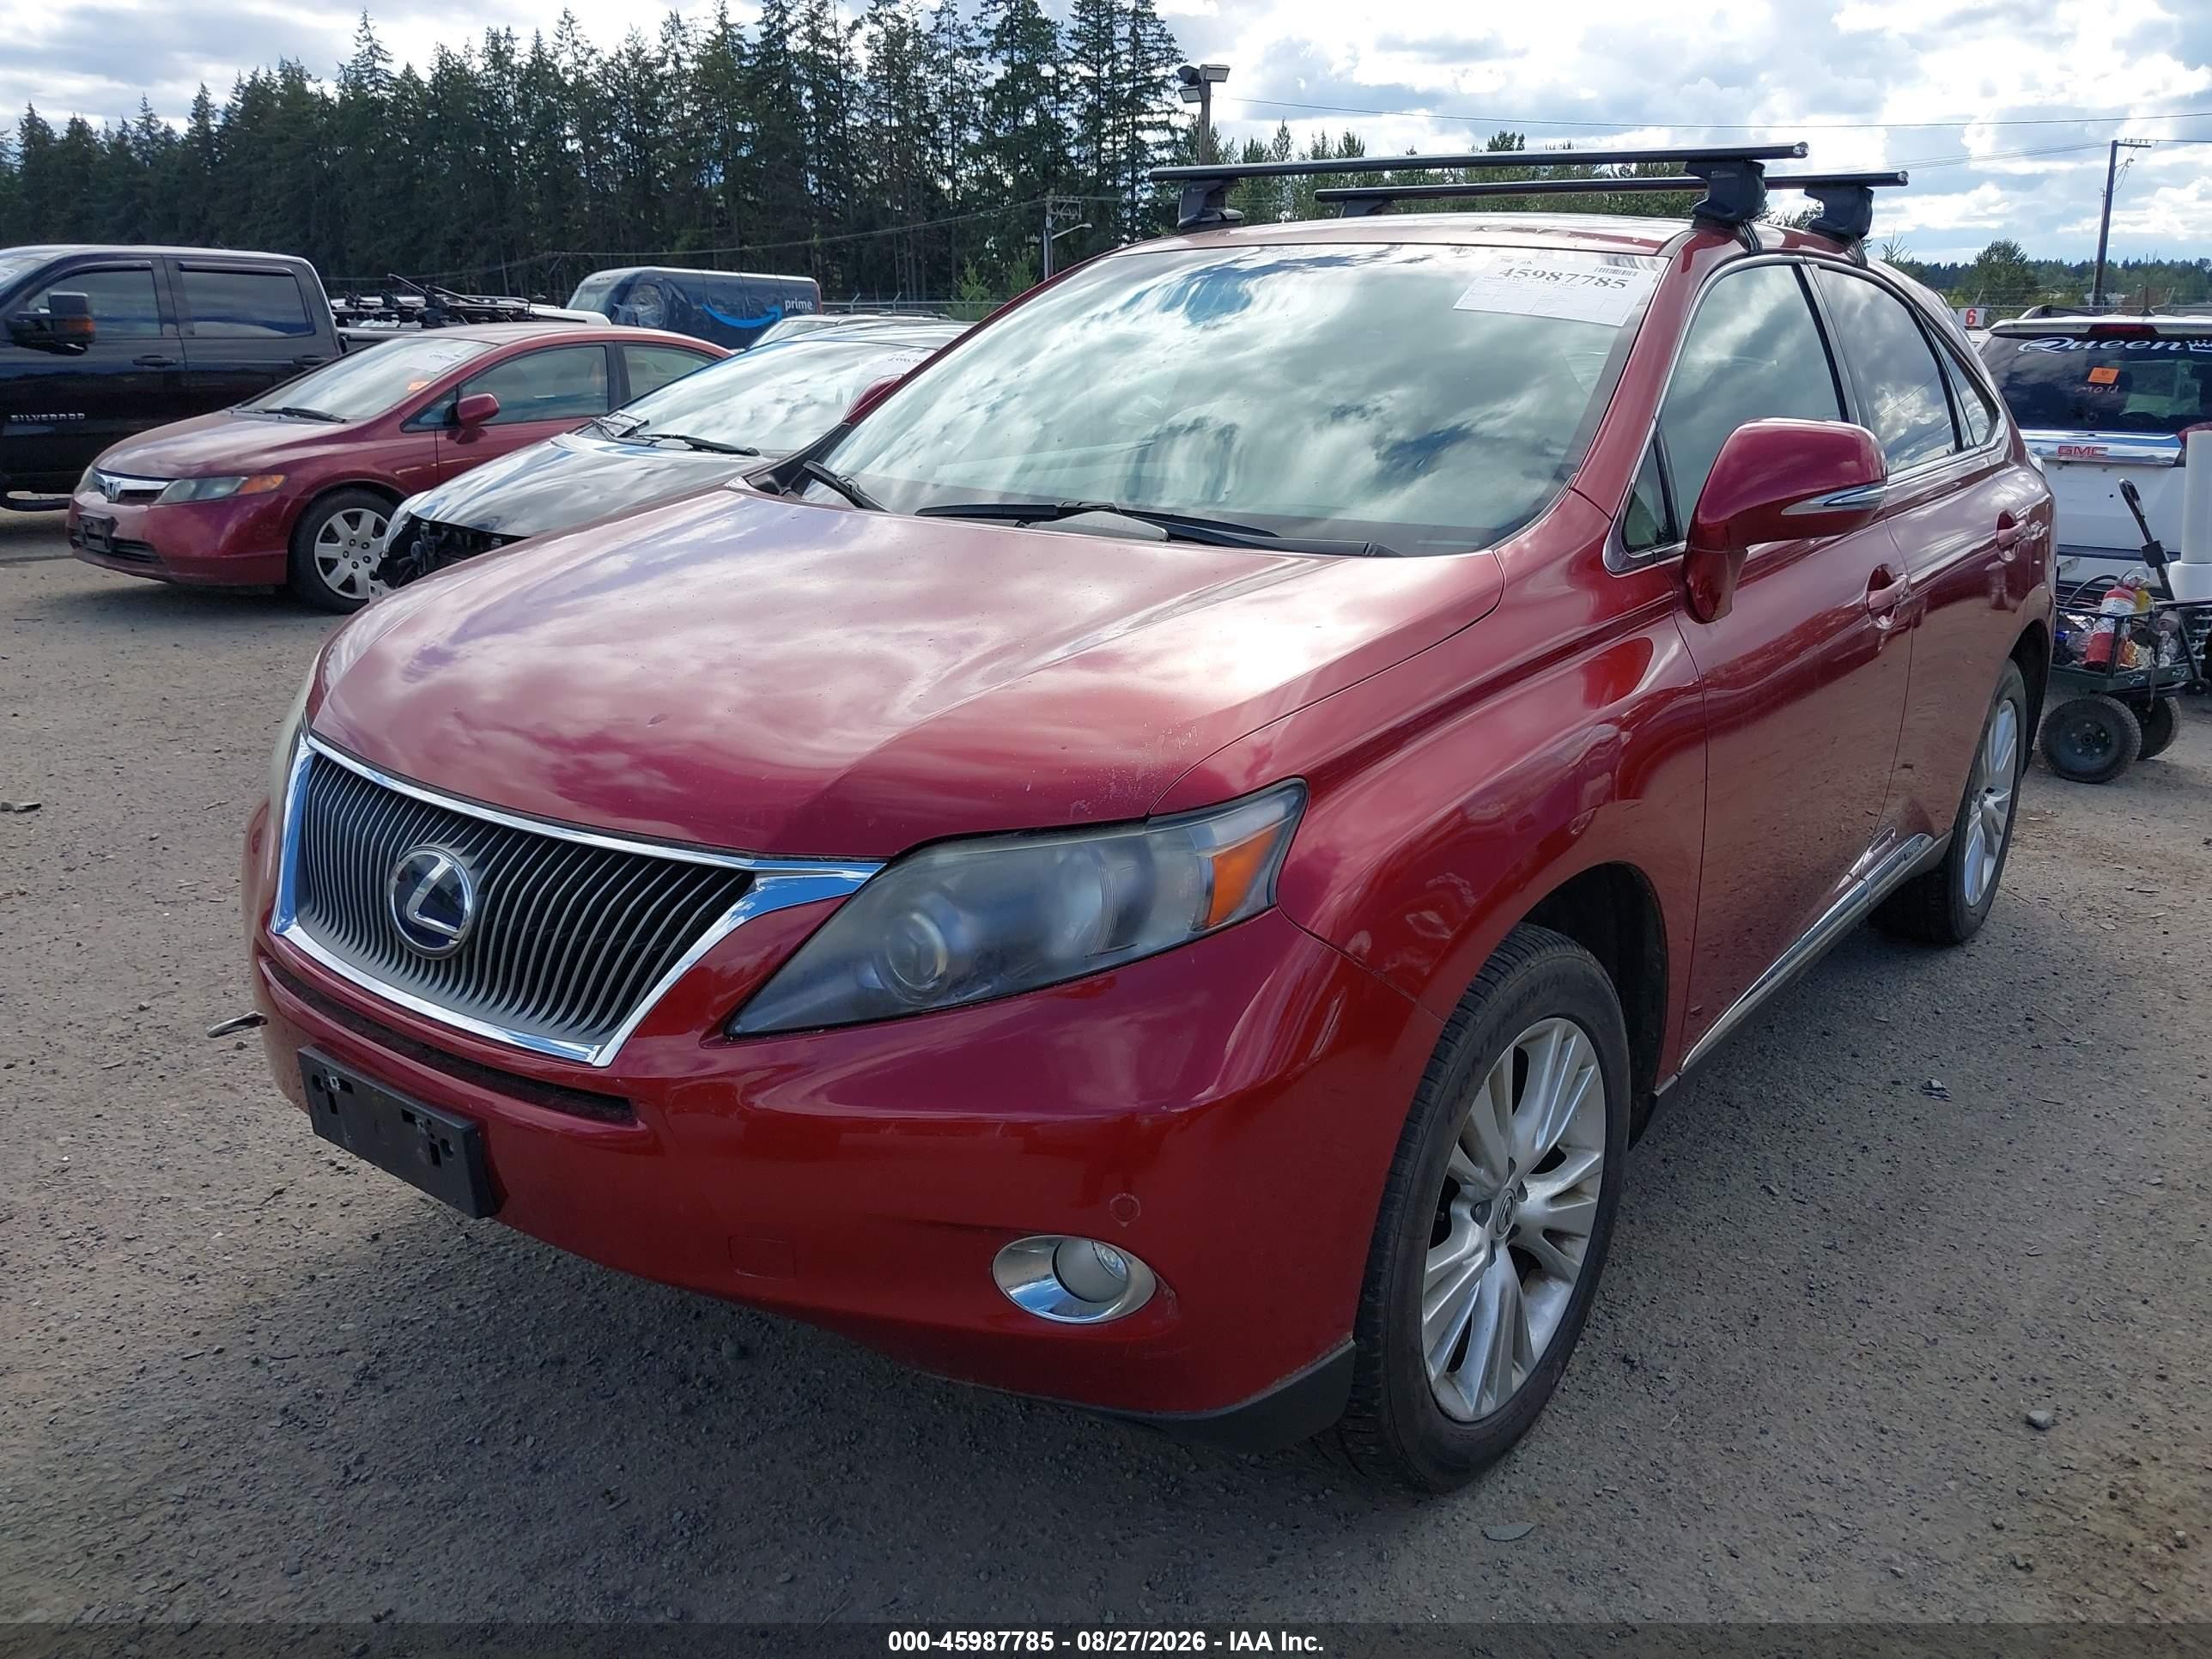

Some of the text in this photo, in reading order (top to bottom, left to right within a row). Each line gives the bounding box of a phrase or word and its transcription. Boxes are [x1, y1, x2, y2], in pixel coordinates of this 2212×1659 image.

[1498, 267, 1629, 289] 45987785
[784, 297, 813, 312] prime
[1965, 309, 1977, 325] 6
[2018, 337, 2184, 354] Queen
[2057, 445, 2109, 457] GMC
